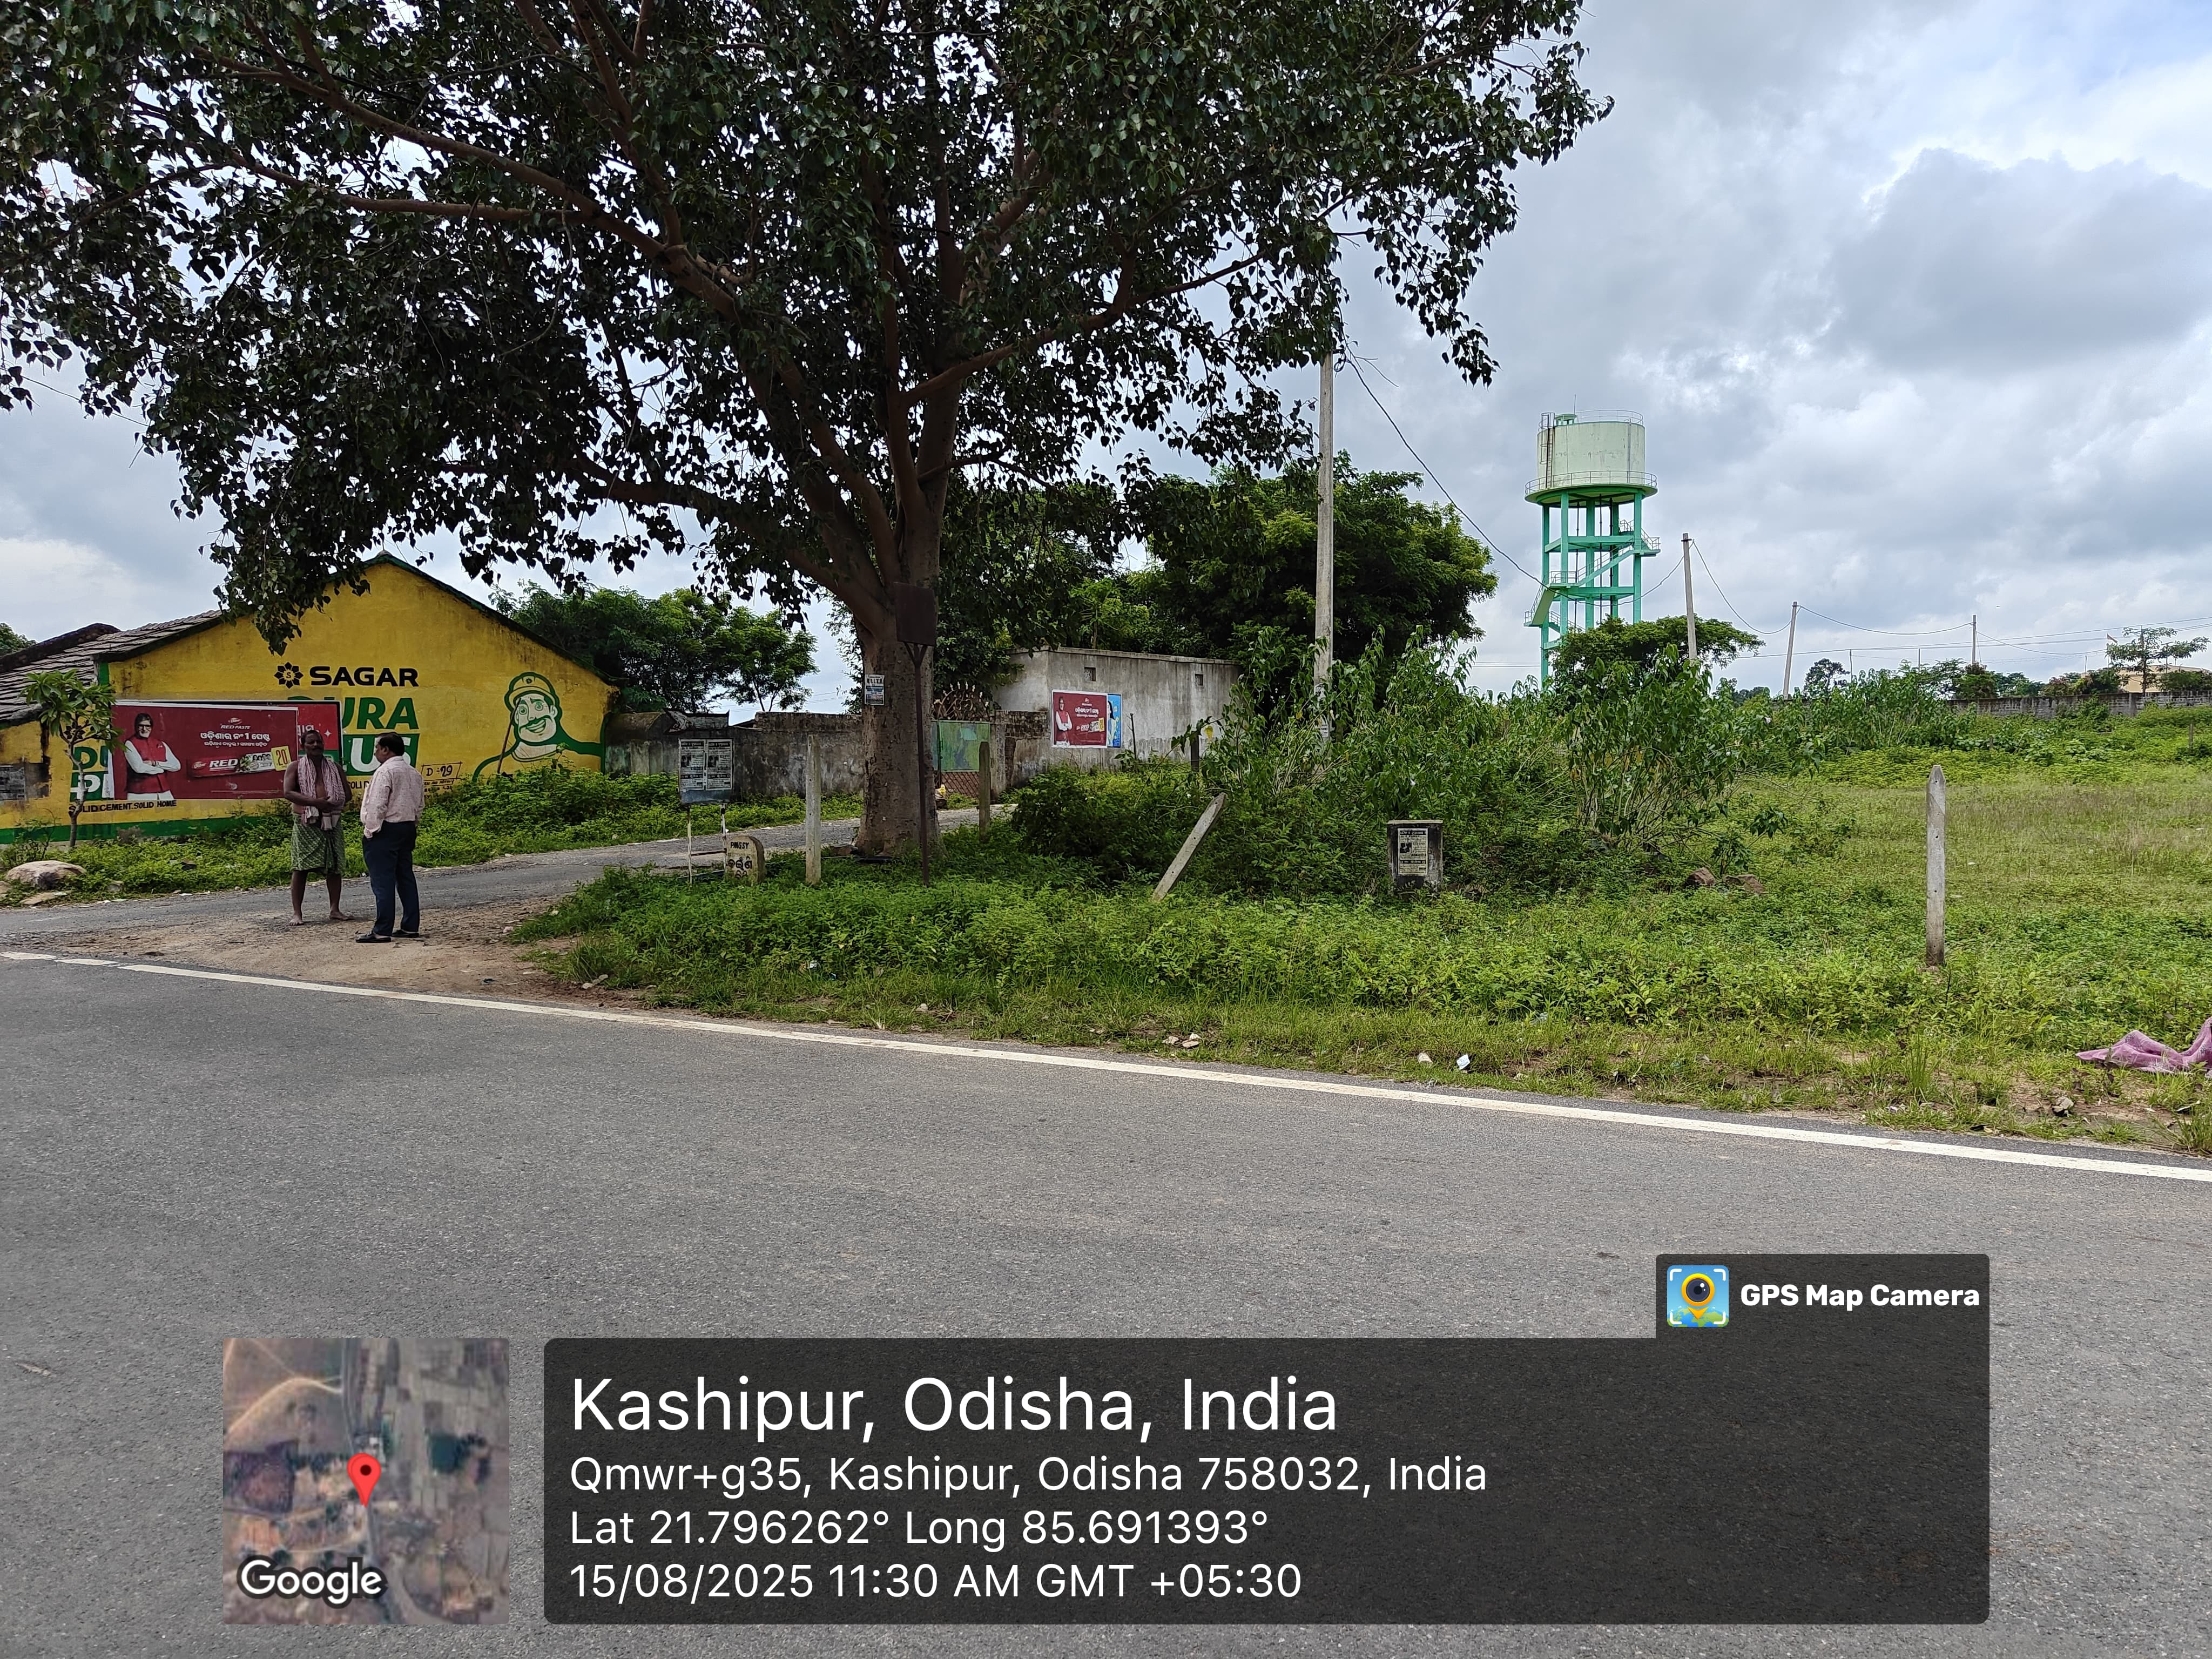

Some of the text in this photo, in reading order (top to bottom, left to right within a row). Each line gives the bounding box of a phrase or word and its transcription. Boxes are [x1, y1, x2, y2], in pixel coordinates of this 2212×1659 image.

[309, 666, 420, 687] SAGAR
[209, 759, 238, 768] RED
[730, 841, 750, 849] PMGSY
